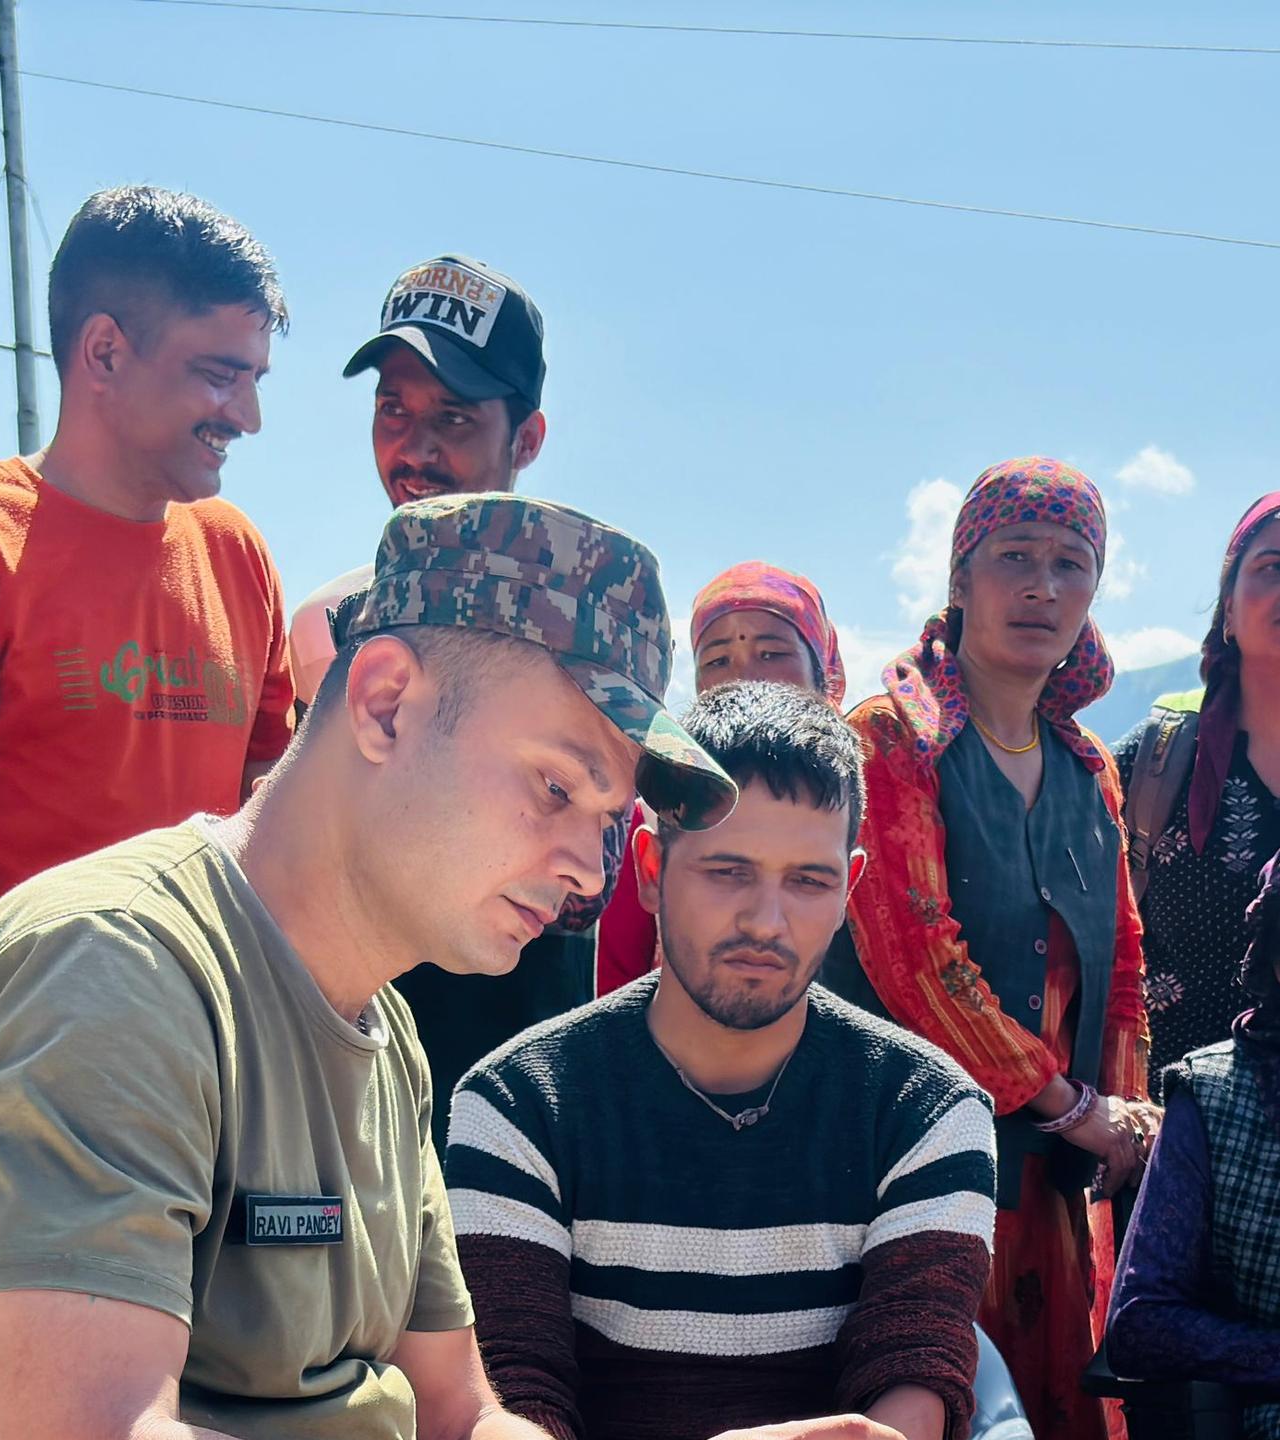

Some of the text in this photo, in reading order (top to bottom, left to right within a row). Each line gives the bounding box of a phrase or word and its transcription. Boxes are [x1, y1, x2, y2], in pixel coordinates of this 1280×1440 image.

[391, 292, 486, 336] WIN
[256, 1215, 340, 1235] RAVI PANDEY
